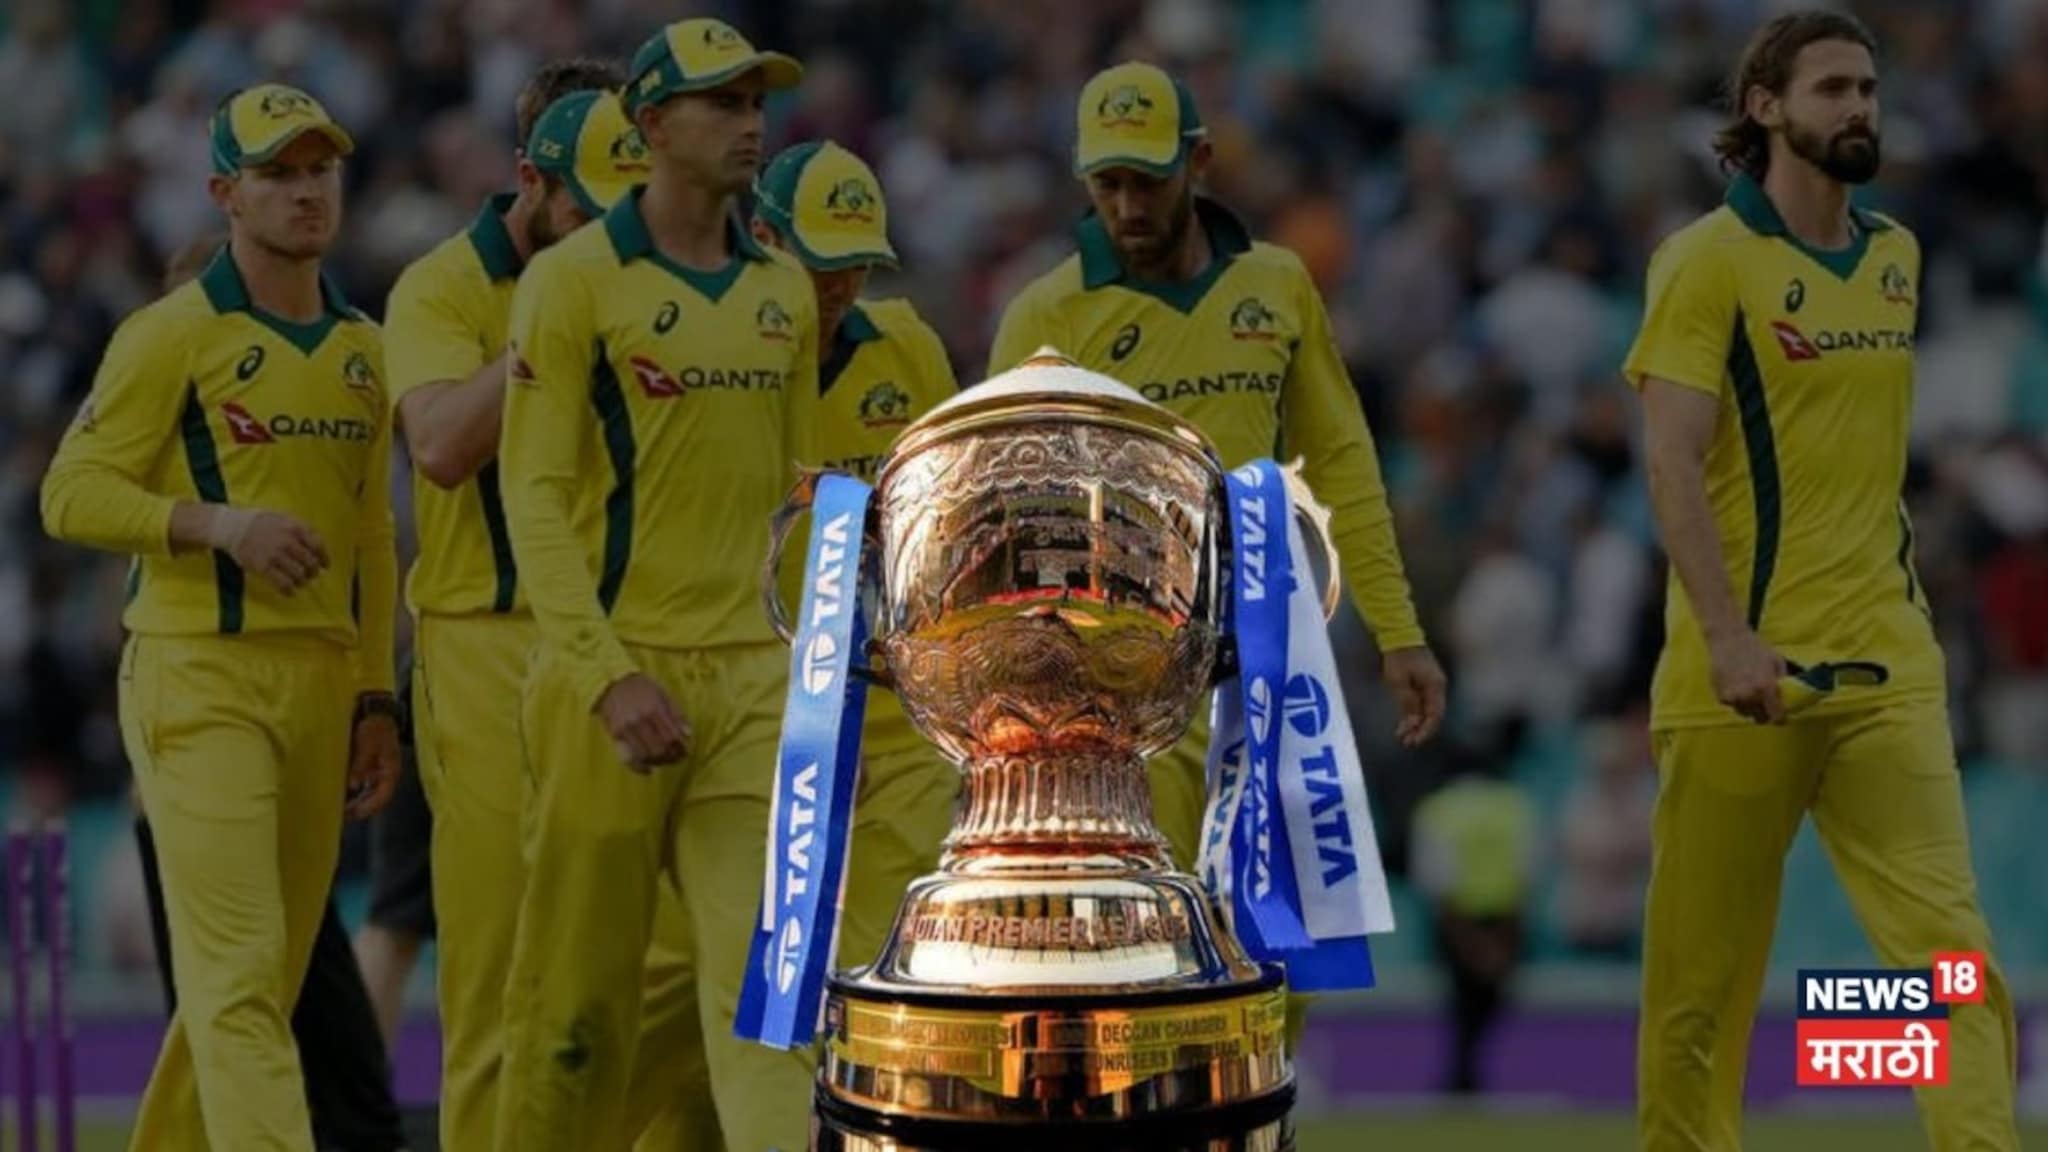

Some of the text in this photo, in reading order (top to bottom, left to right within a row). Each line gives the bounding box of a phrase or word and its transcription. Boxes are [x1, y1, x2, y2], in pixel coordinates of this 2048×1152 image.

[679, 366, 782, 392] QANTA
[1139, 371, 1281, 401] QANTAS
[811, 512, 850, 627] TATA
[1240, 496, 1267, 601] TATA
[784, 761, 819, 906] TATA
[1254, 756, 1271, 901] TATA
[1301, 744, 1357, 889] TATA
[971, 915, 1092, 945] PREMIER
[1101, 1020, 1162, 1044] DECCAN
